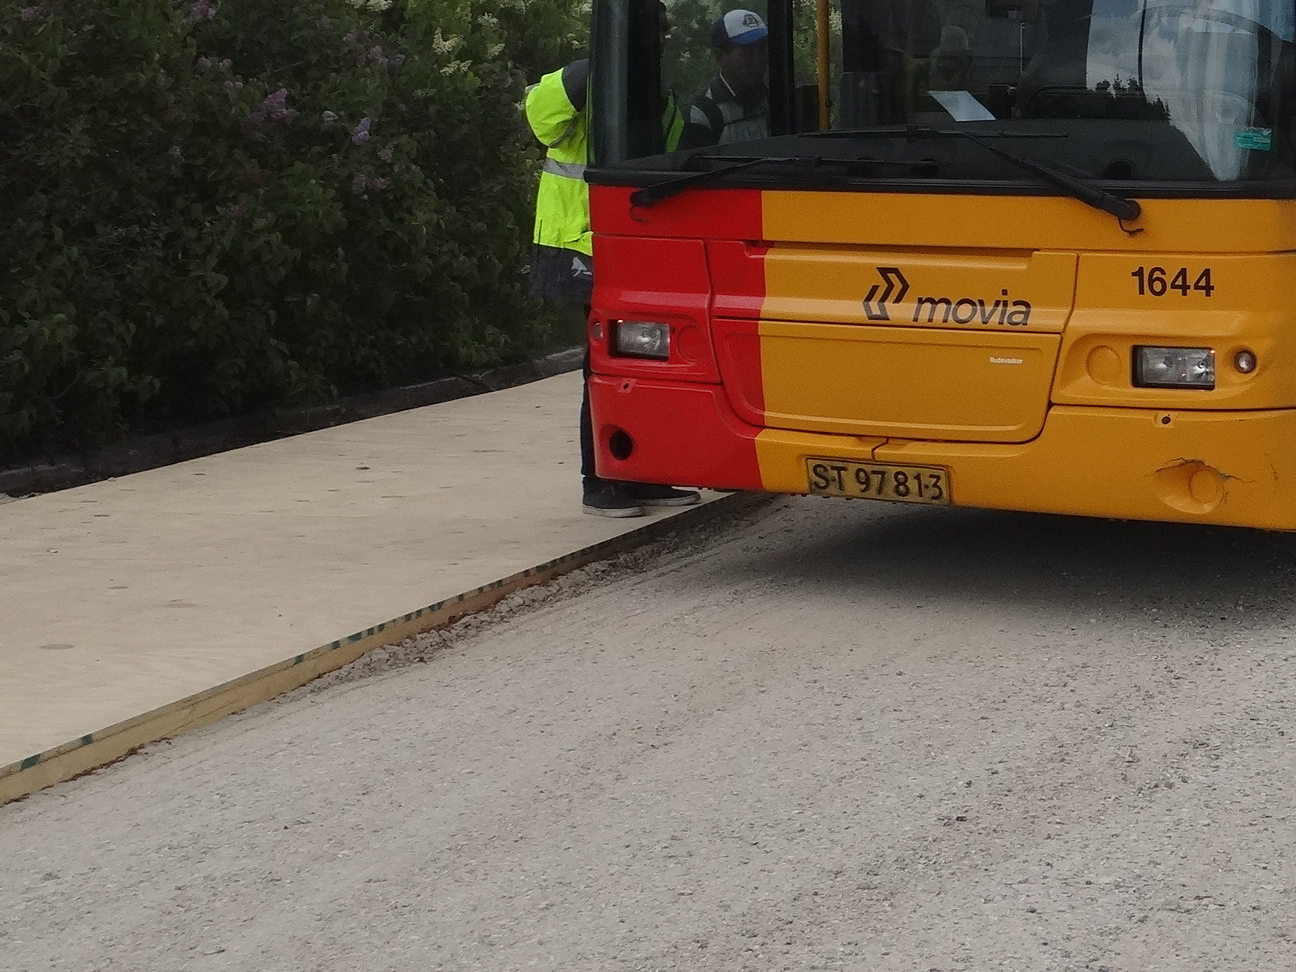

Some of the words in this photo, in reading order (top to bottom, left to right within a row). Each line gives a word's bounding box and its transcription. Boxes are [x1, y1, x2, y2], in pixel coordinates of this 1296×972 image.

[1131, 265, 1215, 298] 1644
[911, 288, 1032, 327] movia
[812, 463, 850, 492] ST
[854, 467, 889, 495] 97
[893, 470, 944, 501] 813
